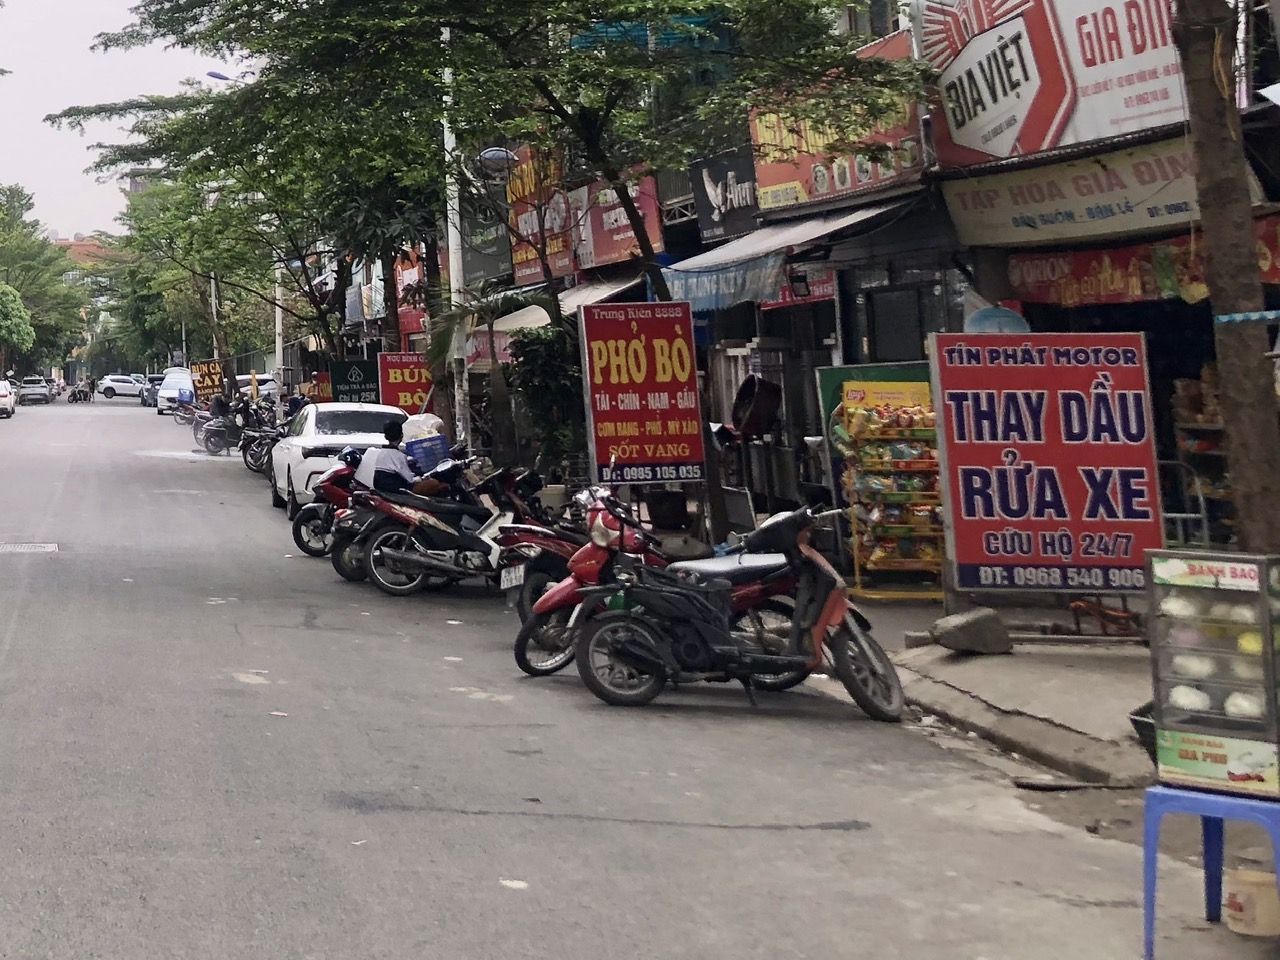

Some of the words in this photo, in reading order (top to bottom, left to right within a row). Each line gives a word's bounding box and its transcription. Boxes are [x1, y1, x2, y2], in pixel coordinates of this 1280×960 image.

[1075, 6, 1123, 68] GIA
[945, 68, 987, 130] BIA
[976, 30, 1030, 105] VIỆT
[1071, 166, 1128, 197] GIA
[1131, 152, 1198, 186] ĐÌN
[592, 308, 625, 321] Trung
[628, 307, 652, 320] Kiên
[655, 306, 683, 318] 8888
[591, 321, 647, 384] PHỞ
[652, 324, 691, 383] BÒ
[943, 342, 982, 366] TÍN
[986, 342, 1048, 367] PHÁT
[1052, 346, 1140, 368] MOTOR
[194, 374, 221, 387] CAY
[388, 364, 433, 383] BÚN
[360, 391, 377, 401] 25K
[398, 388, 427, 406] BÒ
[945, 390, 1048, 444] THAY
[1058, 371, 1147, 445] DẦU
[608, 438, 640, 458] SỐT
[643, 443, 690, 457] VANG
[623, 466, 653, 480] 0985
[655, 465, 676, 479] 105
[679, 465, 701, 478] 035
[958, 447, 1070, 521] RỬA
[1077, 466, 1154, 521] XE
[983, 526, 1033, 556] CỨU
[1038, 526, 1074, 562] HỘ
[1080, 532, 1135, 559] 24/7
[979, 567, 1008, 586] ĐT:
[1013, 567, 1061, 586] 0968
[1067, 567, 1103, 587] 540
[1109, 568, 1145, 587] 906
